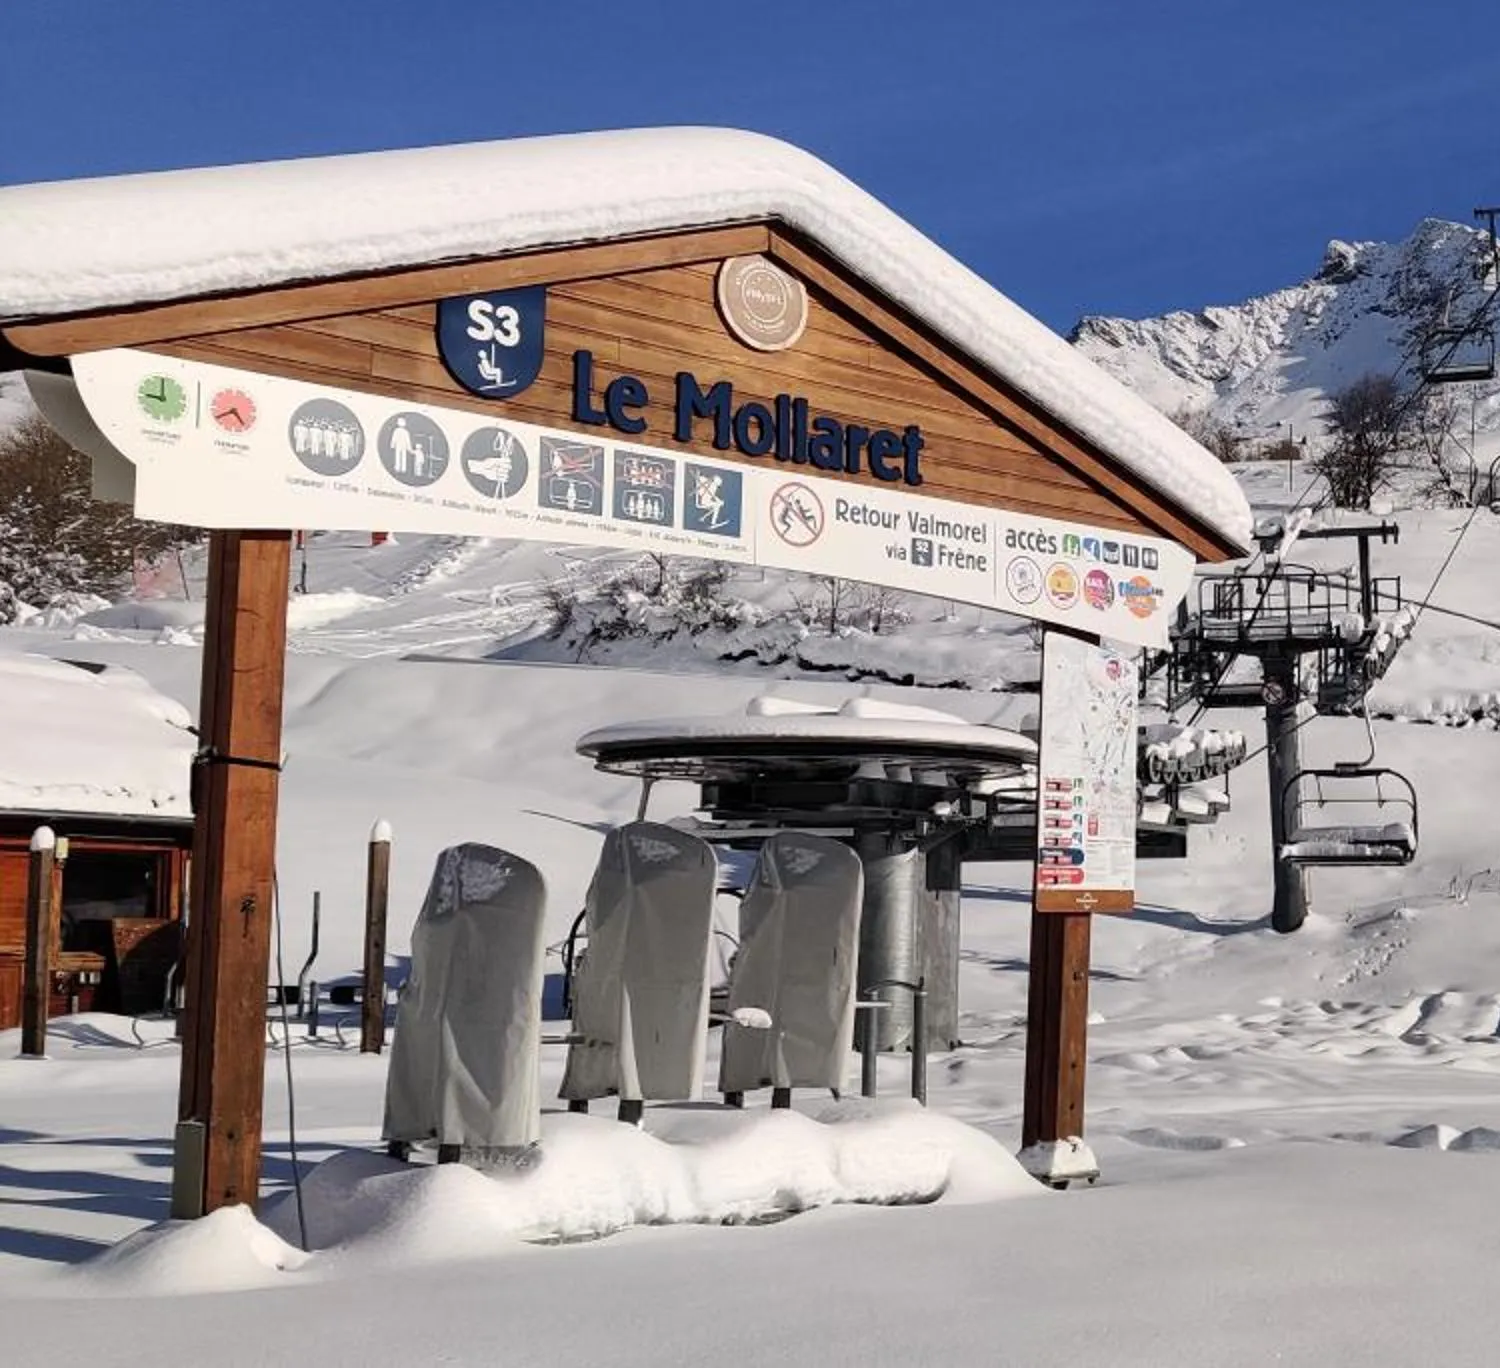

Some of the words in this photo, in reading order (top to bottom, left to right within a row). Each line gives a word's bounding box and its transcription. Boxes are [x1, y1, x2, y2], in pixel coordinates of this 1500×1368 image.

[466, 299, 520, 347] S3
[572, 350, 649, 434] Le
[674, 371, 924, 486] Mollaret
[835, 498, 901, 530] Retour
[907, 511, 987, 544] Valmorel
[1005, 527, 1058, 555] accès
[885, 542, 907, 561] via
[938, 544, 987, 572] Frêne
